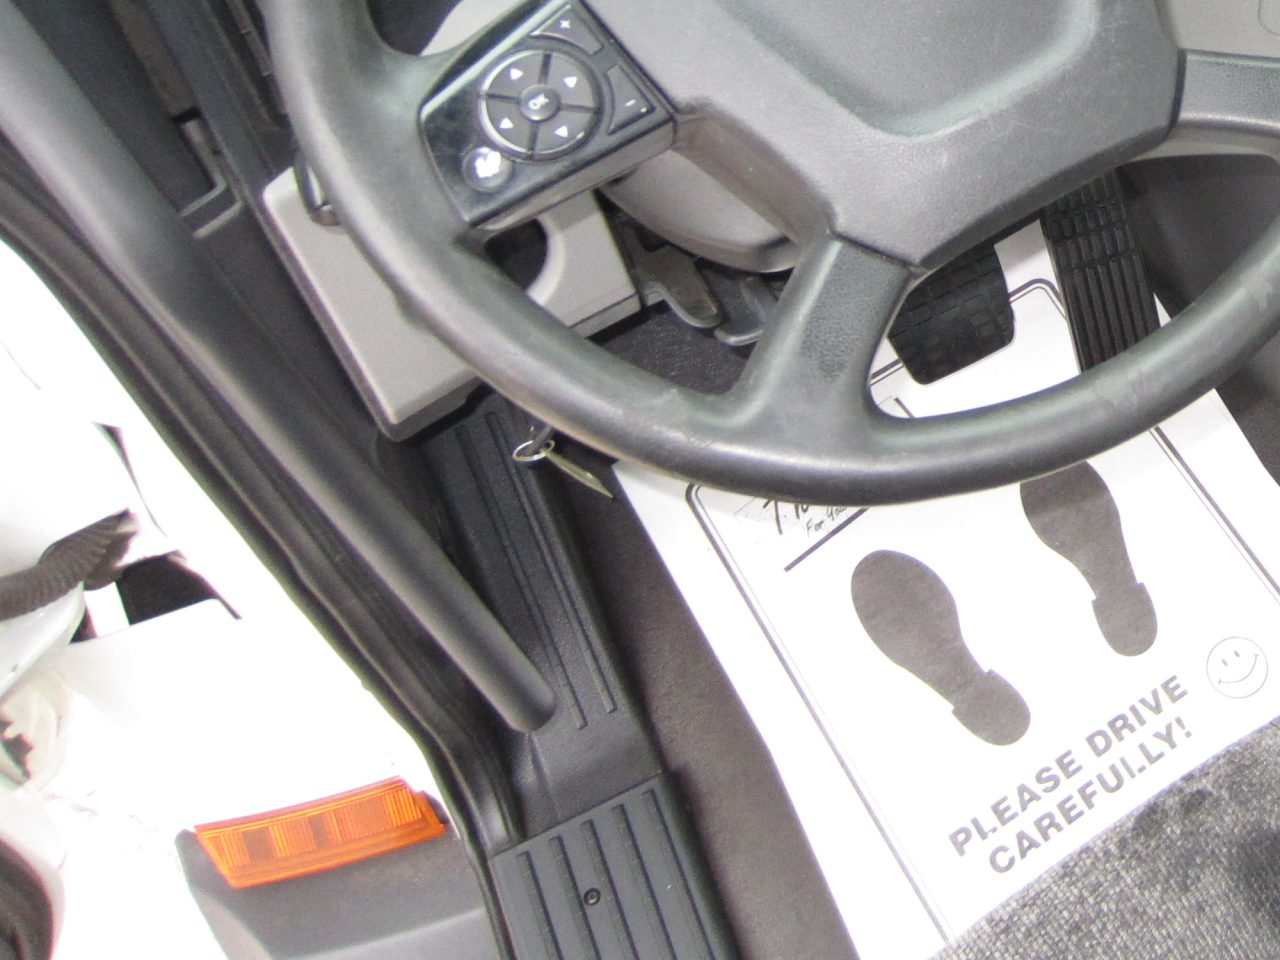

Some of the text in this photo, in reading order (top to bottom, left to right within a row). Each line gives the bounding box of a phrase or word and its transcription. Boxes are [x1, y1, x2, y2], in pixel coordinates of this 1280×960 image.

[528, 92, 550, 110] OK
[948, 674, 1188, 857] PLEASE DRIVE
[988, 716, 1192, 873] CAREFULLY!
